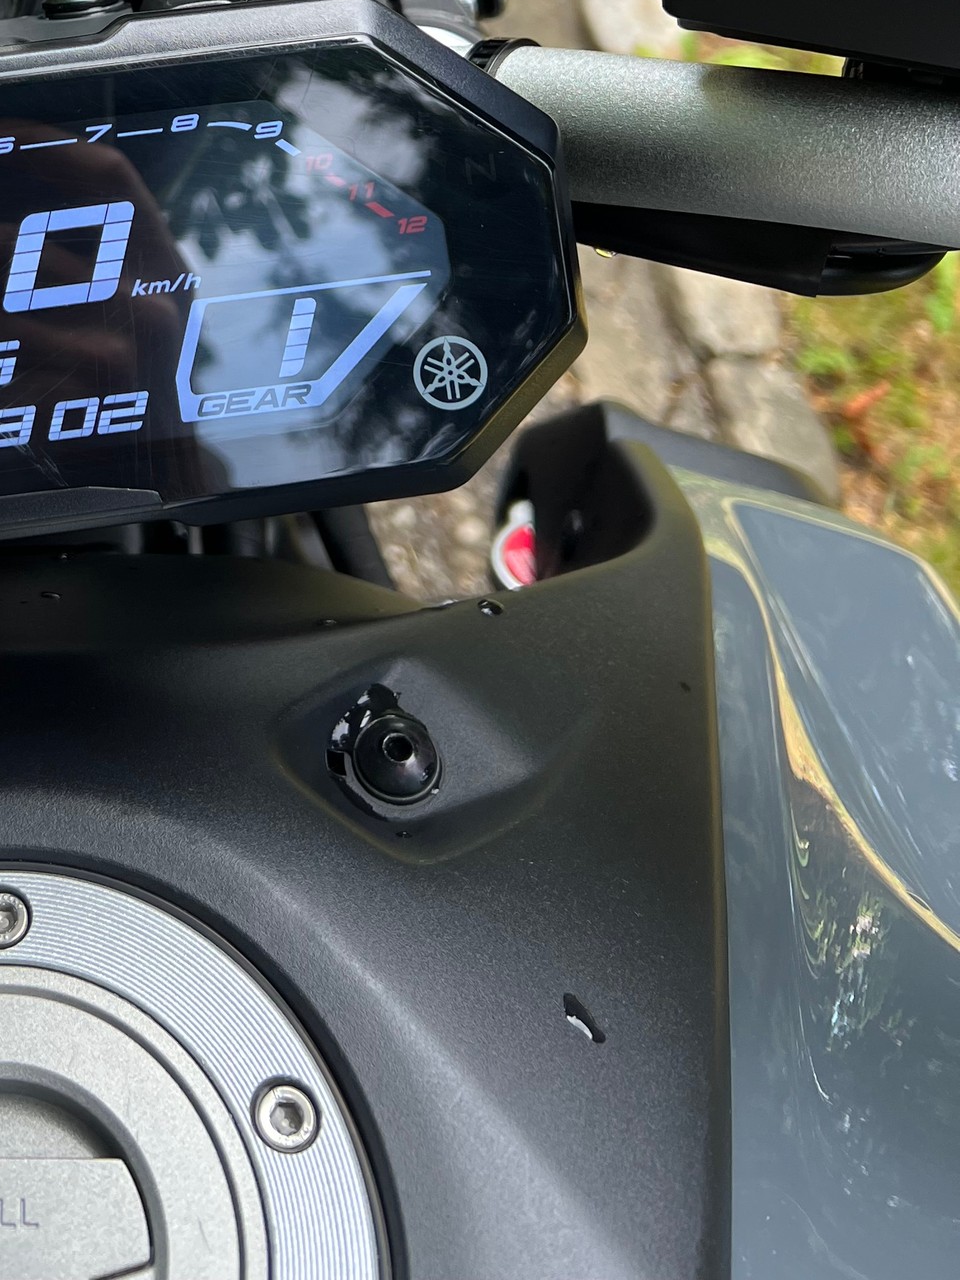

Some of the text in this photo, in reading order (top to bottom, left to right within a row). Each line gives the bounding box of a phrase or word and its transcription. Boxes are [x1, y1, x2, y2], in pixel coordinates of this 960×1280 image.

[84, 123, 113, 143] 7
[171, 113, 200, 133] 8
[253, 120, 284, 139] 9
[304, 153, 334, 172] 10
[348, 181, 375, 202] 11
[397, 215, 428, 235] 12
[1, 200, 202, 314] 0 km/h
[279, 297, 316, 379] 1
[196, 383, 313, 419] GEAR
